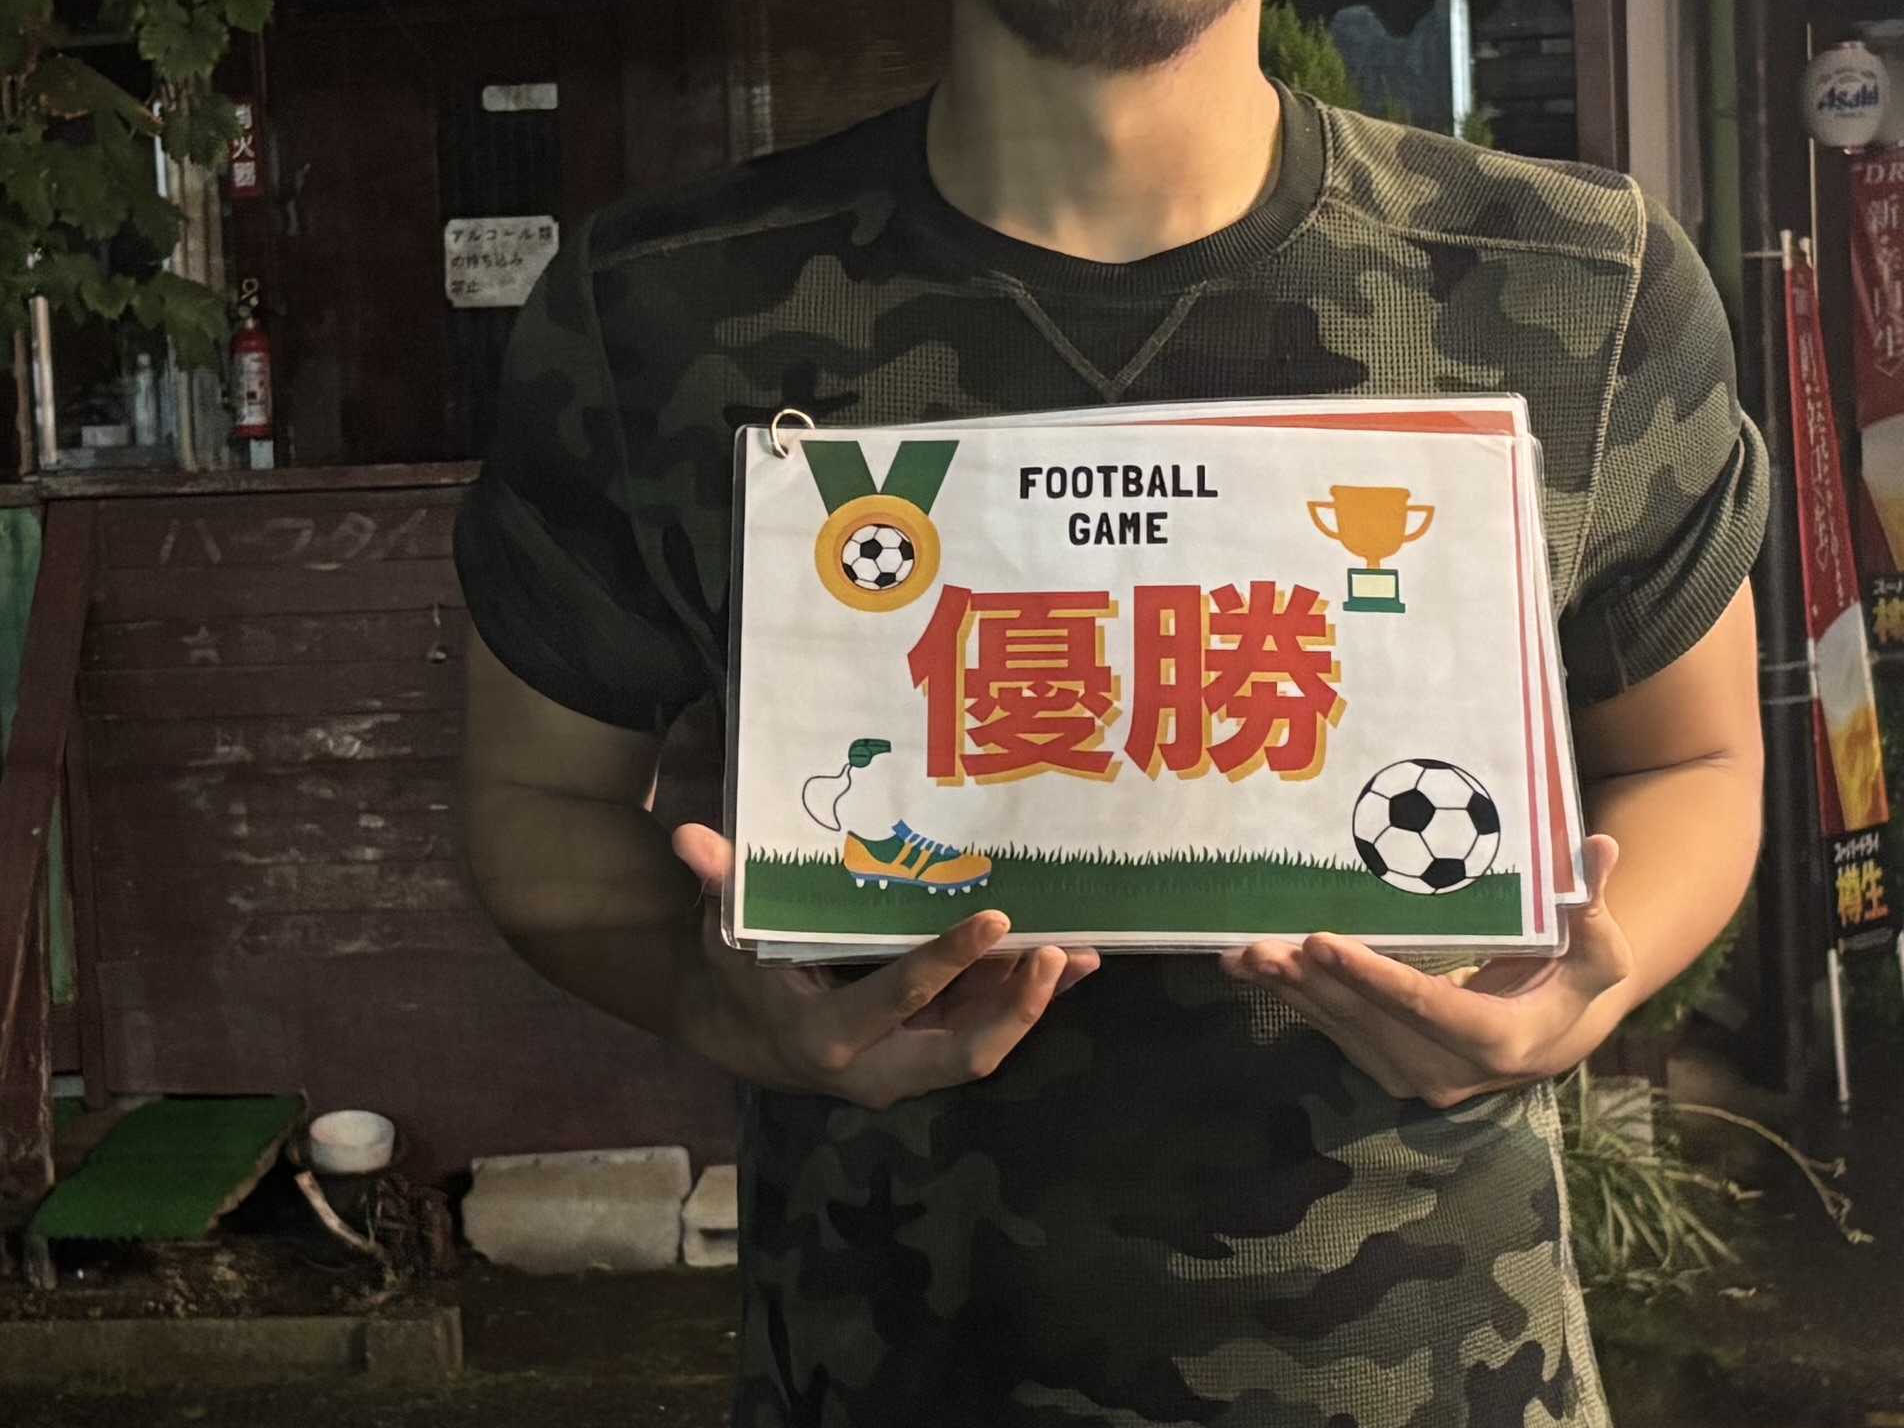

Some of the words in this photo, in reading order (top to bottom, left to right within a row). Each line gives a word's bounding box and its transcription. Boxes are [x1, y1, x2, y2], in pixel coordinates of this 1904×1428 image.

[1817, 83, 1880, 110] Asahi
[1019, 464, 1220, 500] FOOTBALL
[1068, 511, 1169, 547] GAME
[906, 580, 1348, 786] 優勝
[1835, 859, 1890, 928] 樽生
